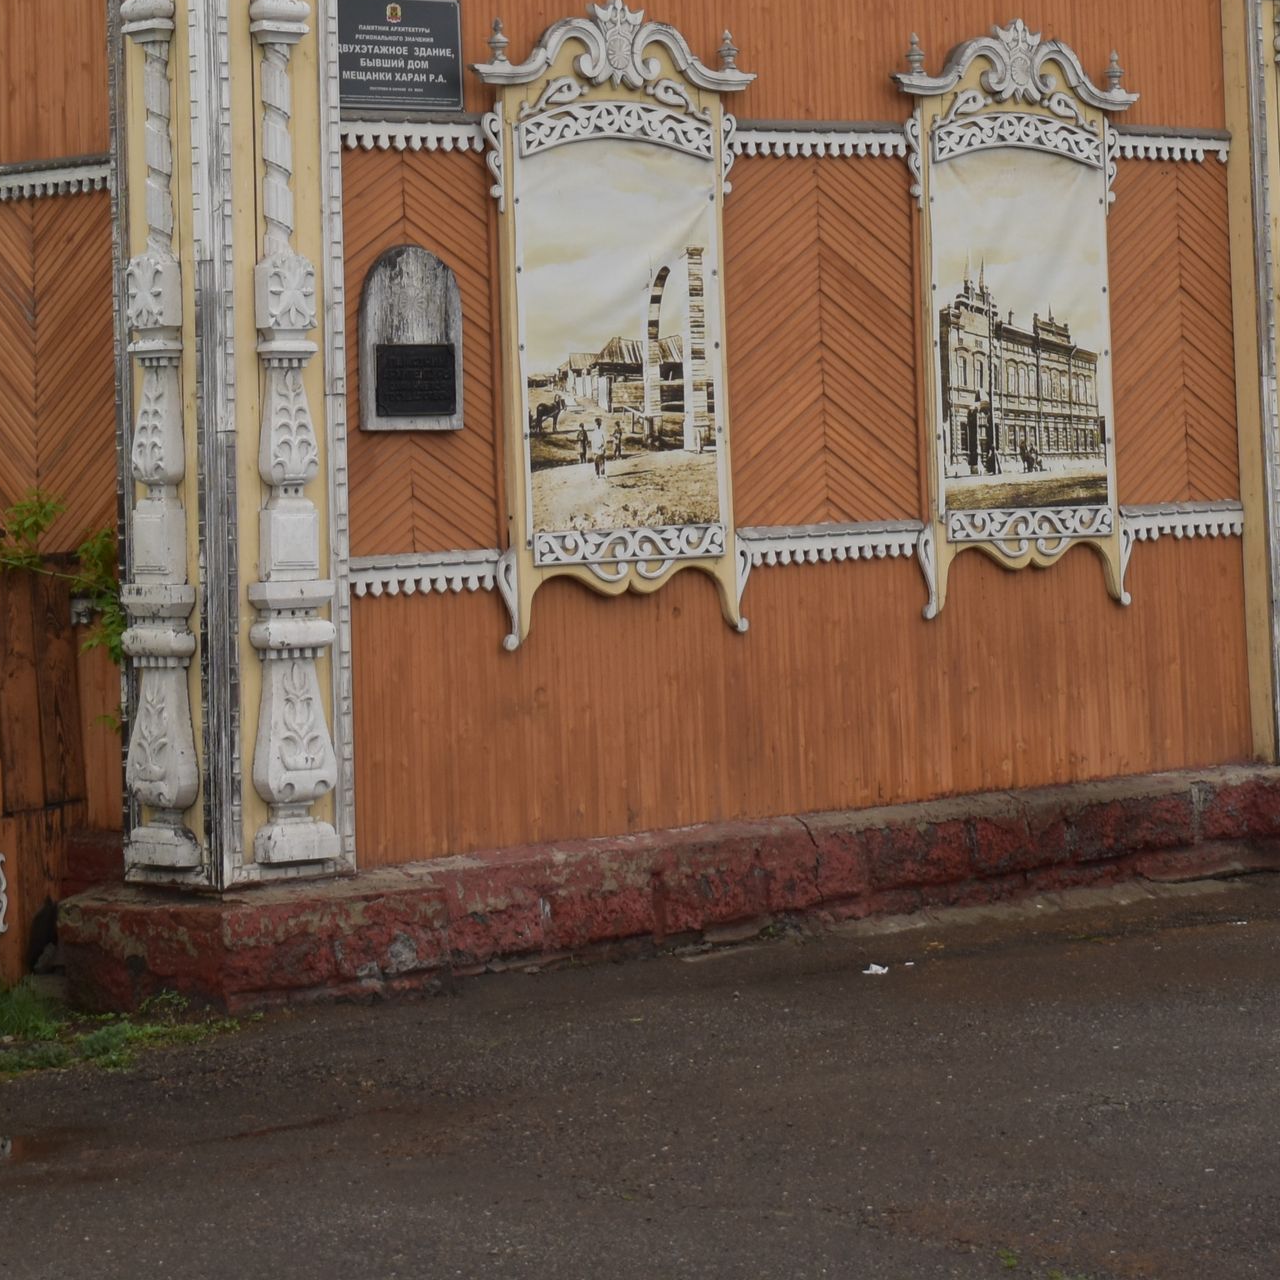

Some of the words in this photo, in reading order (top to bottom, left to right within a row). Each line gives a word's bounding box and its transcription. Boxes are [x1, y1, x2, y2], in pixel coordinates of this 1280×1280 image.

[355, 33, 404, 42] РЕГИОНАЛЬНОГО
[414, 47, 455, 59] ЗДАНИЕ,
[360, 58, 405, 67] БЫВШИЙ
[407, 60, 429, 70] ДОМ
[342, 70, 392, 81] МЕЩАНКИ
[394, 72, 427, 82] ХАРАН
[429, 75, 447, 83] Р.А.
